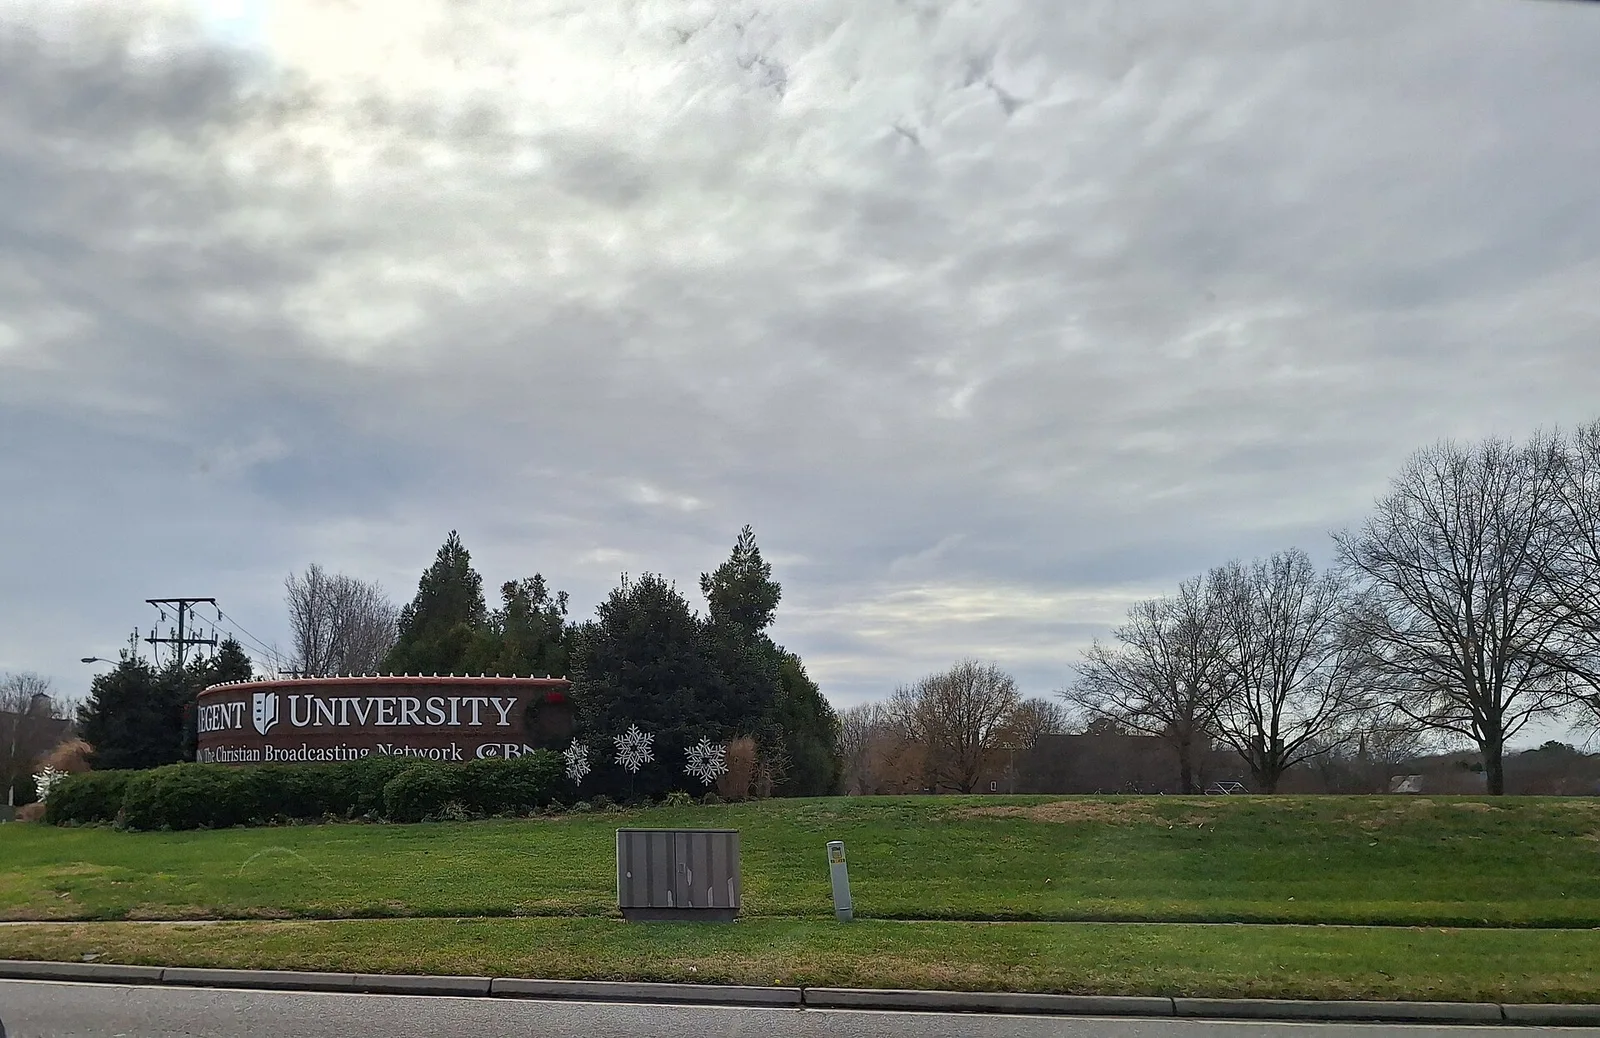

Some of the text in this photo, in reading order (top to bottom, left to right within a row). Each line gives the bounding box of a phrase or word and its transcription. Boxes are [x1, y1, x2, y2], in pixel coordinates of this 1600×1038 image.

[288, 694, 518, 727] UNIVERSITY
[204, 747, 215, 764] The
[216, 744, 260, 763] Christian
[377, 743, 463, 761] Network
